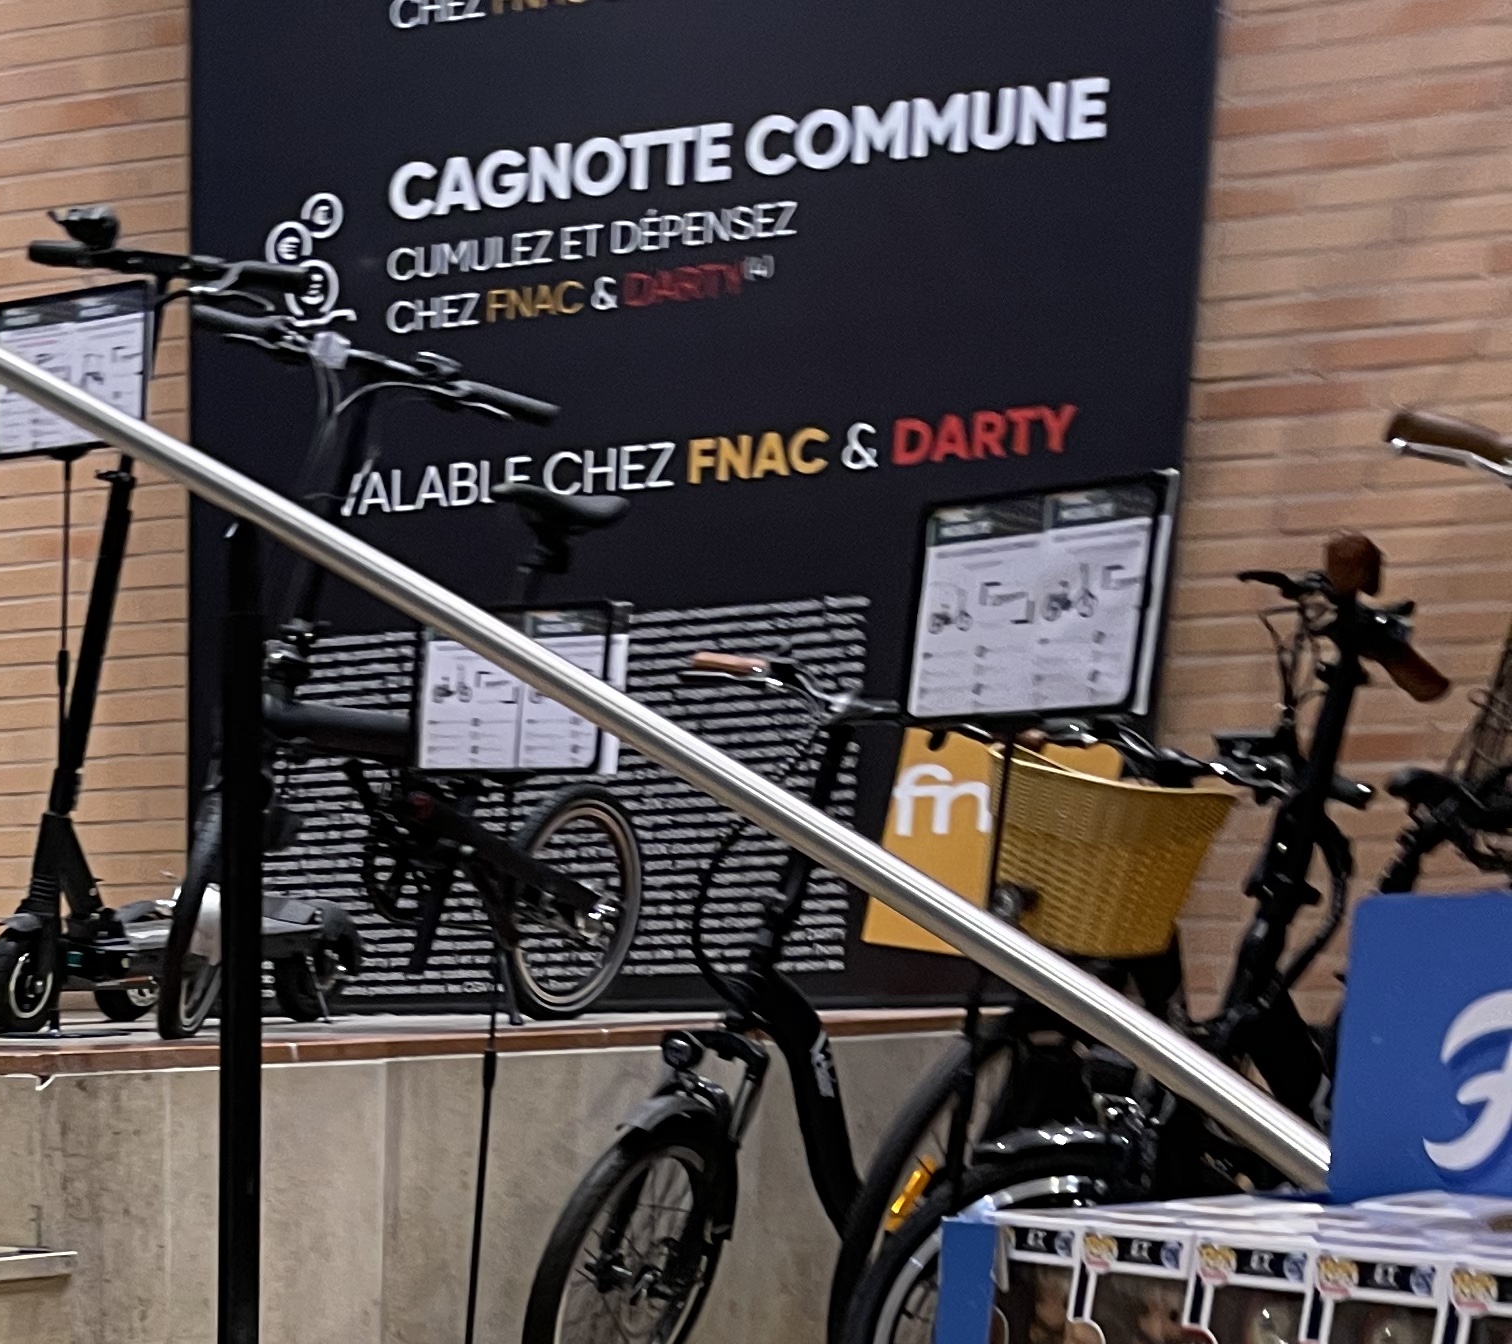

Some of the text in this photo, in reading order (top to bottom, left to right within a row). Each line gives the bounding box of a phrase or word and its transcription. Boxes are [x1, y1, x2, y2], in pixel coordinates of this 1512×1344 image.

[388, 77, 1111, 221] CAGNOTTE COMMUNE
[387, 200, 799, 281] CUMULEZ ET DÉPENSEZ
[387, 292, 481, 334] CHEZ
[485, 280, 586, 323] FNAC
[590, 276, 619, 311] &
[622, 261, 742, 307] DARTY
[542, 441, 677, 495] CHEZ
[687, 427, 830, 484] FNAC
[840, 422, 879, 470] &
[891, 404, 1078, 466] DARTY
